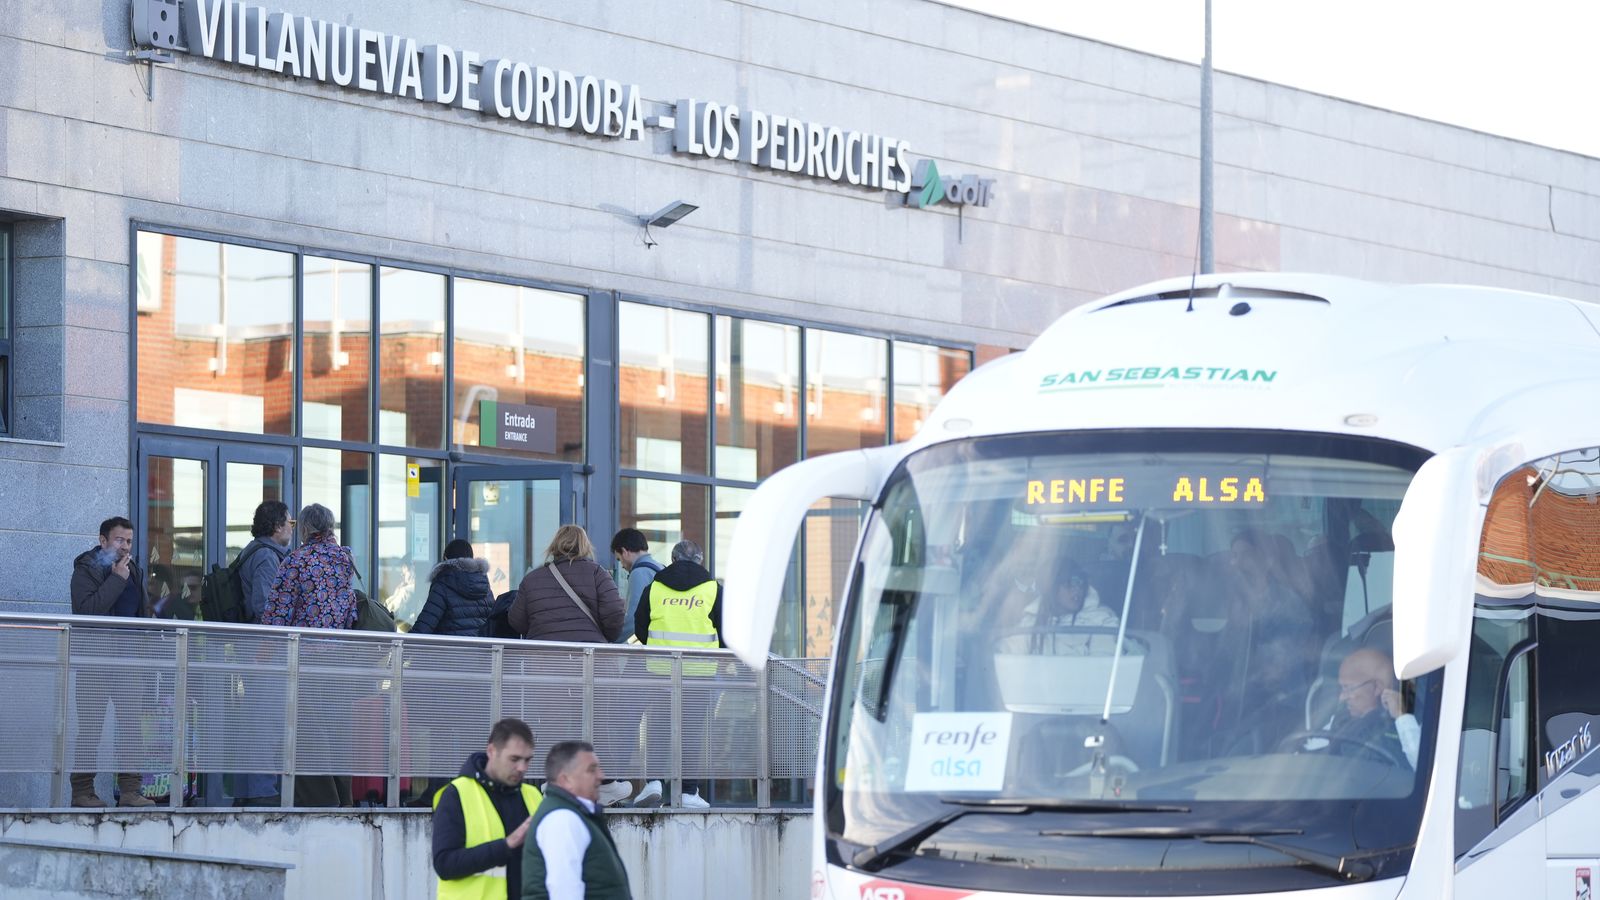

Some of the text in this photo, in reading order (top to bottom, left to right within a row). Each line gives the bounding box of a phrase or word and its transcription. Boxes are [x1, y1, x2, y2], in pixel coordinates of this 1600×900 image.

[196, 0, 423, 100] VILLANUEVA
[436, 43, 480, 111] DE
[493, 58, 645, 141] CORDOBA
[688, 98, 740, 161] LOS
[751, 110, 912, 193] PEDROCHES
[1039, 367, 1277, 388] SAN SEBASTIAN
[504, 412, 536, 429] Entrada
[504, 431, 528, 443] ENTRANCE
[1027, 477, 1264, 504] RENFE ALSA
[662, 595, 704, 611] renfe
[923, 722, 997, 754] renfe
[930, 757, 982, 777] alsa
